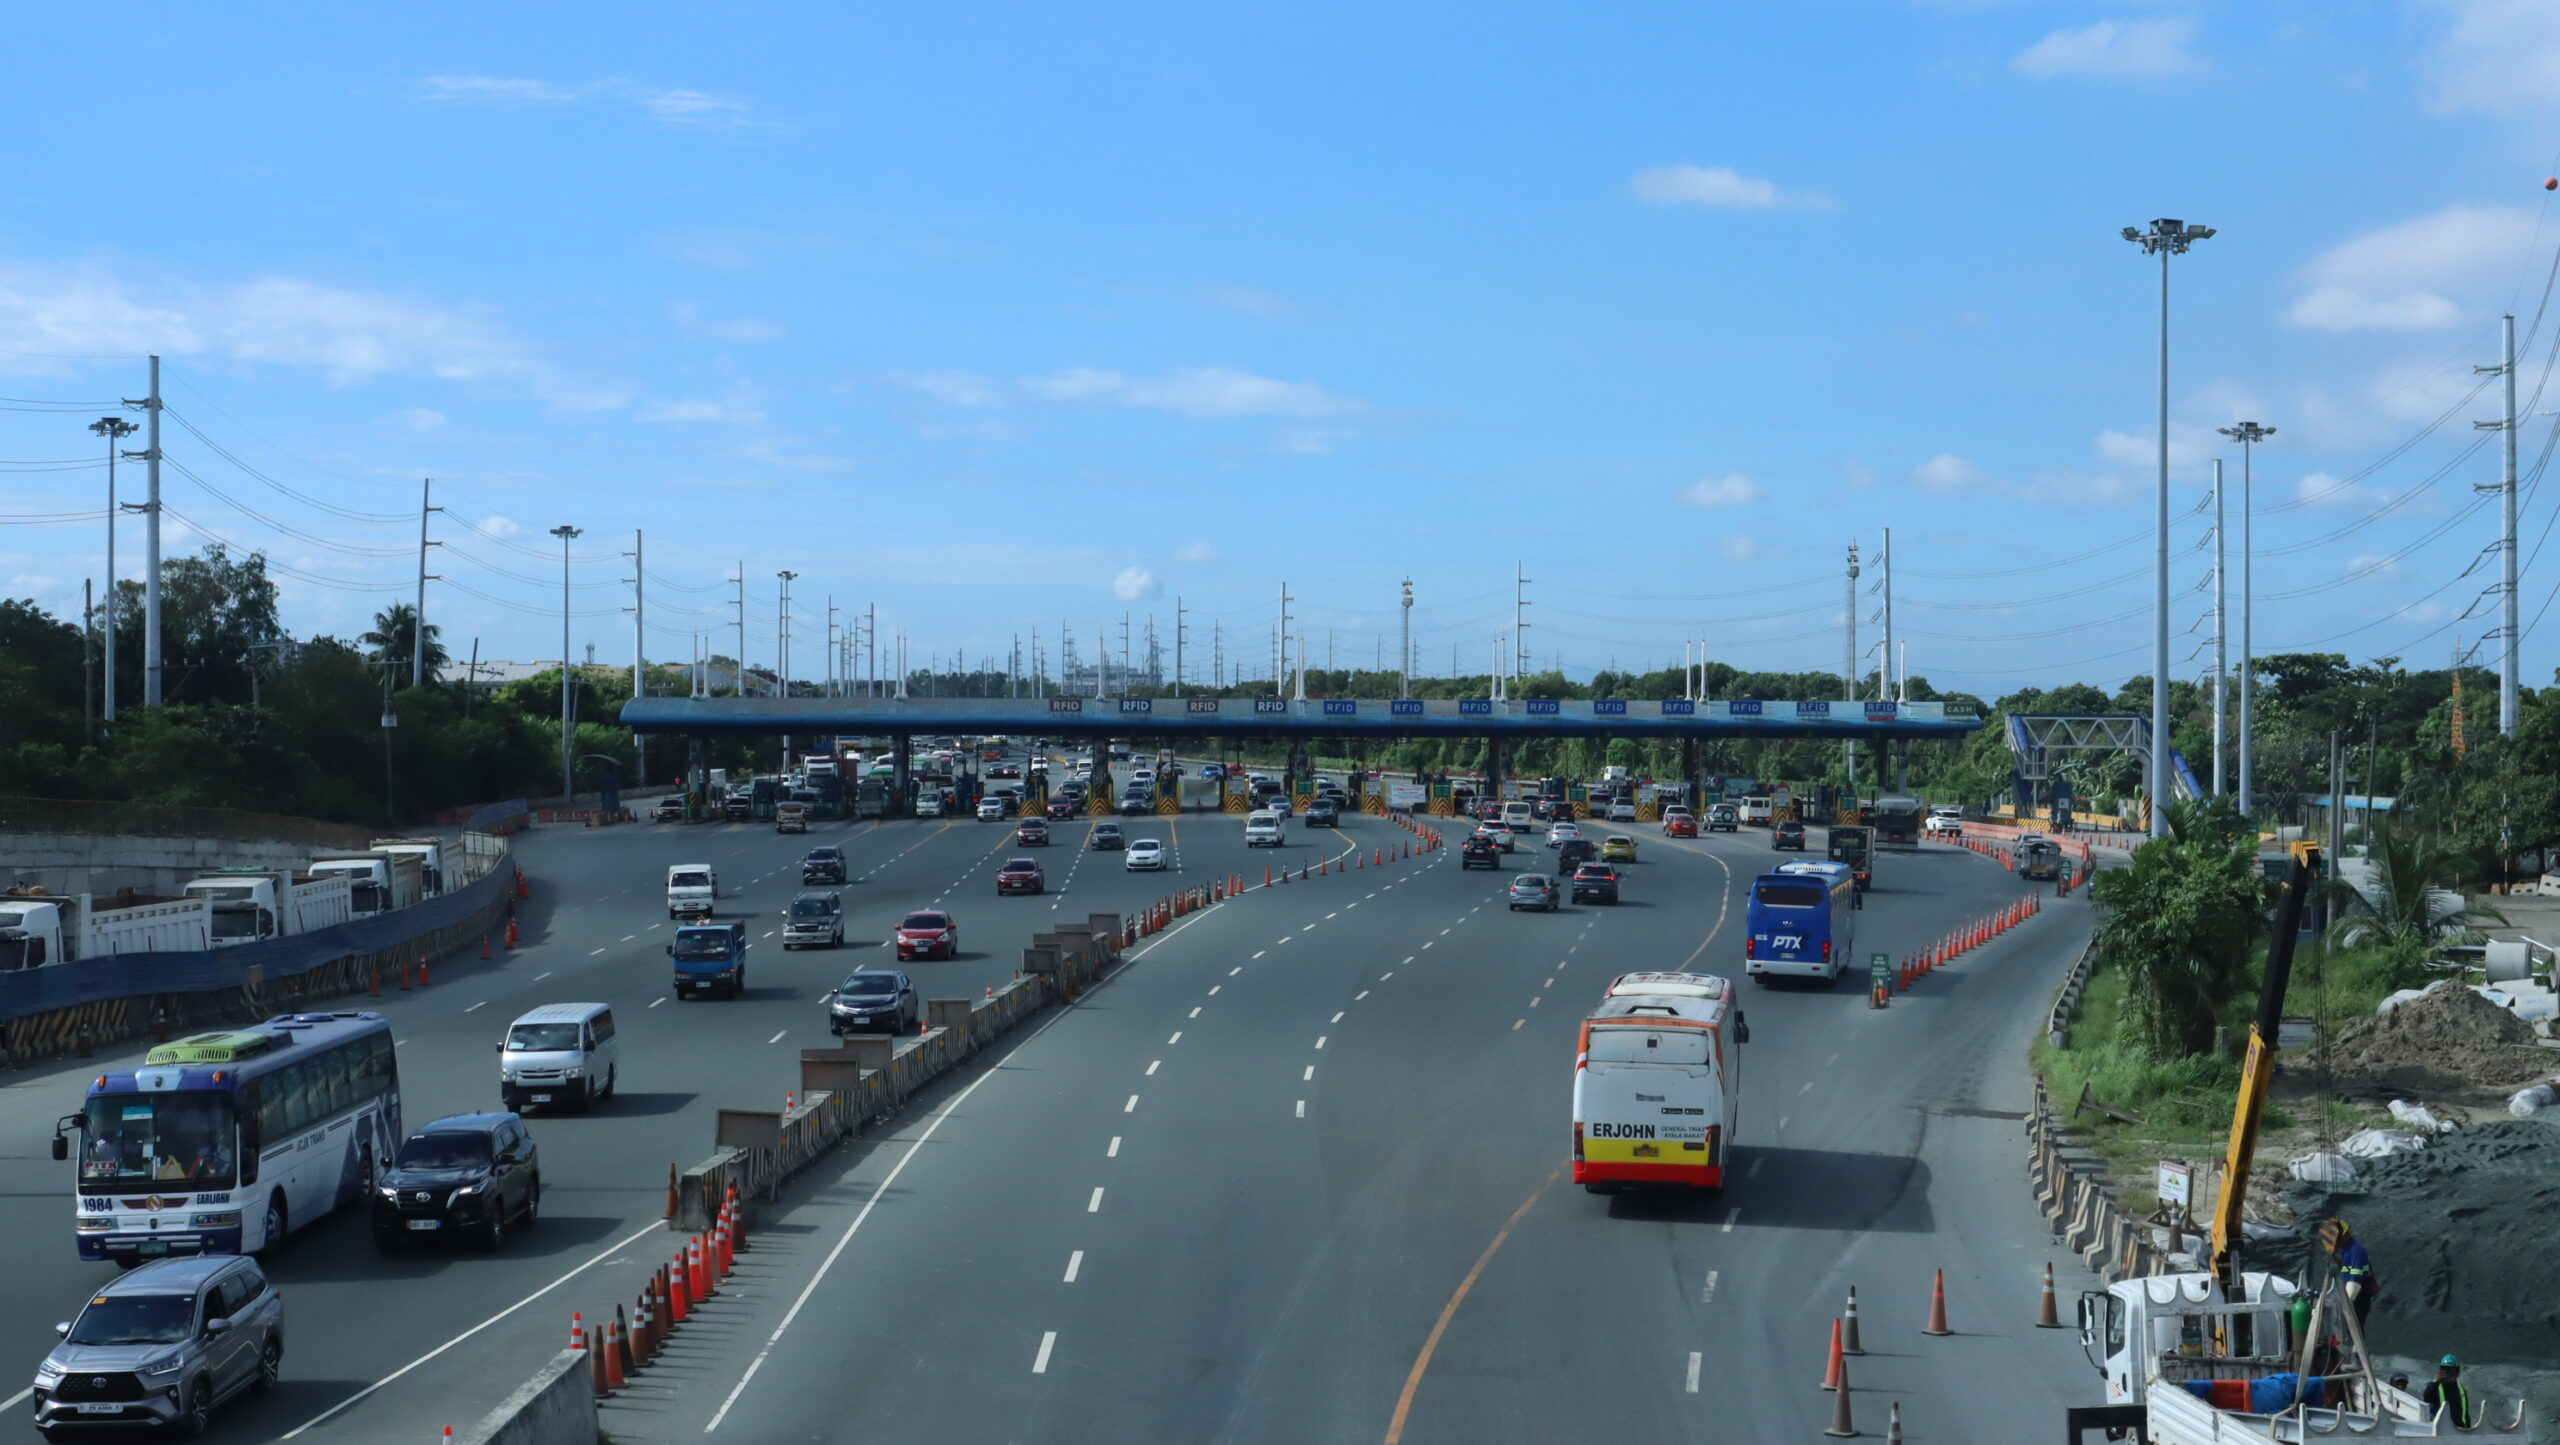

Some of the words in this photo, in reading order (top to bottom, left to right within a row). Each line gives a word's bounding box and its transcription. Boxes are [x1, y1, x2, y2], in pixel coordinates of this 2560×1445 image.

[1052, 701, 1079, 711] RFID
[1123, 701, 1149, 711] RFID
[1190, 701, 1216, 711] RFID
[1258, 701, 1284, 711] RFID
[1326, 703, 1353, 712] RFID
[1394, 703, 1421, 712] RFID
[1462, 703, 1489, 712] RFID
[1529, 703, 1556, 712] RFID
[1597, 703, 1623, 712] RFID
[1664, 703, 1691, 712] RFID
[1732, 703, 1759, 712] RFID
[1799, 703, 1826, 711] RFID
[1867, 703, 1894, 711] RFID
[1946, 705, 1972, 713] CASH
[1772, 935, 1802, 949] PTX
[1593, 1122, 1656, 1139] ERJOHN
[196, 1193, 231, 1205] EARLJOHN
[83, 1198, 113, 1212] 1984
